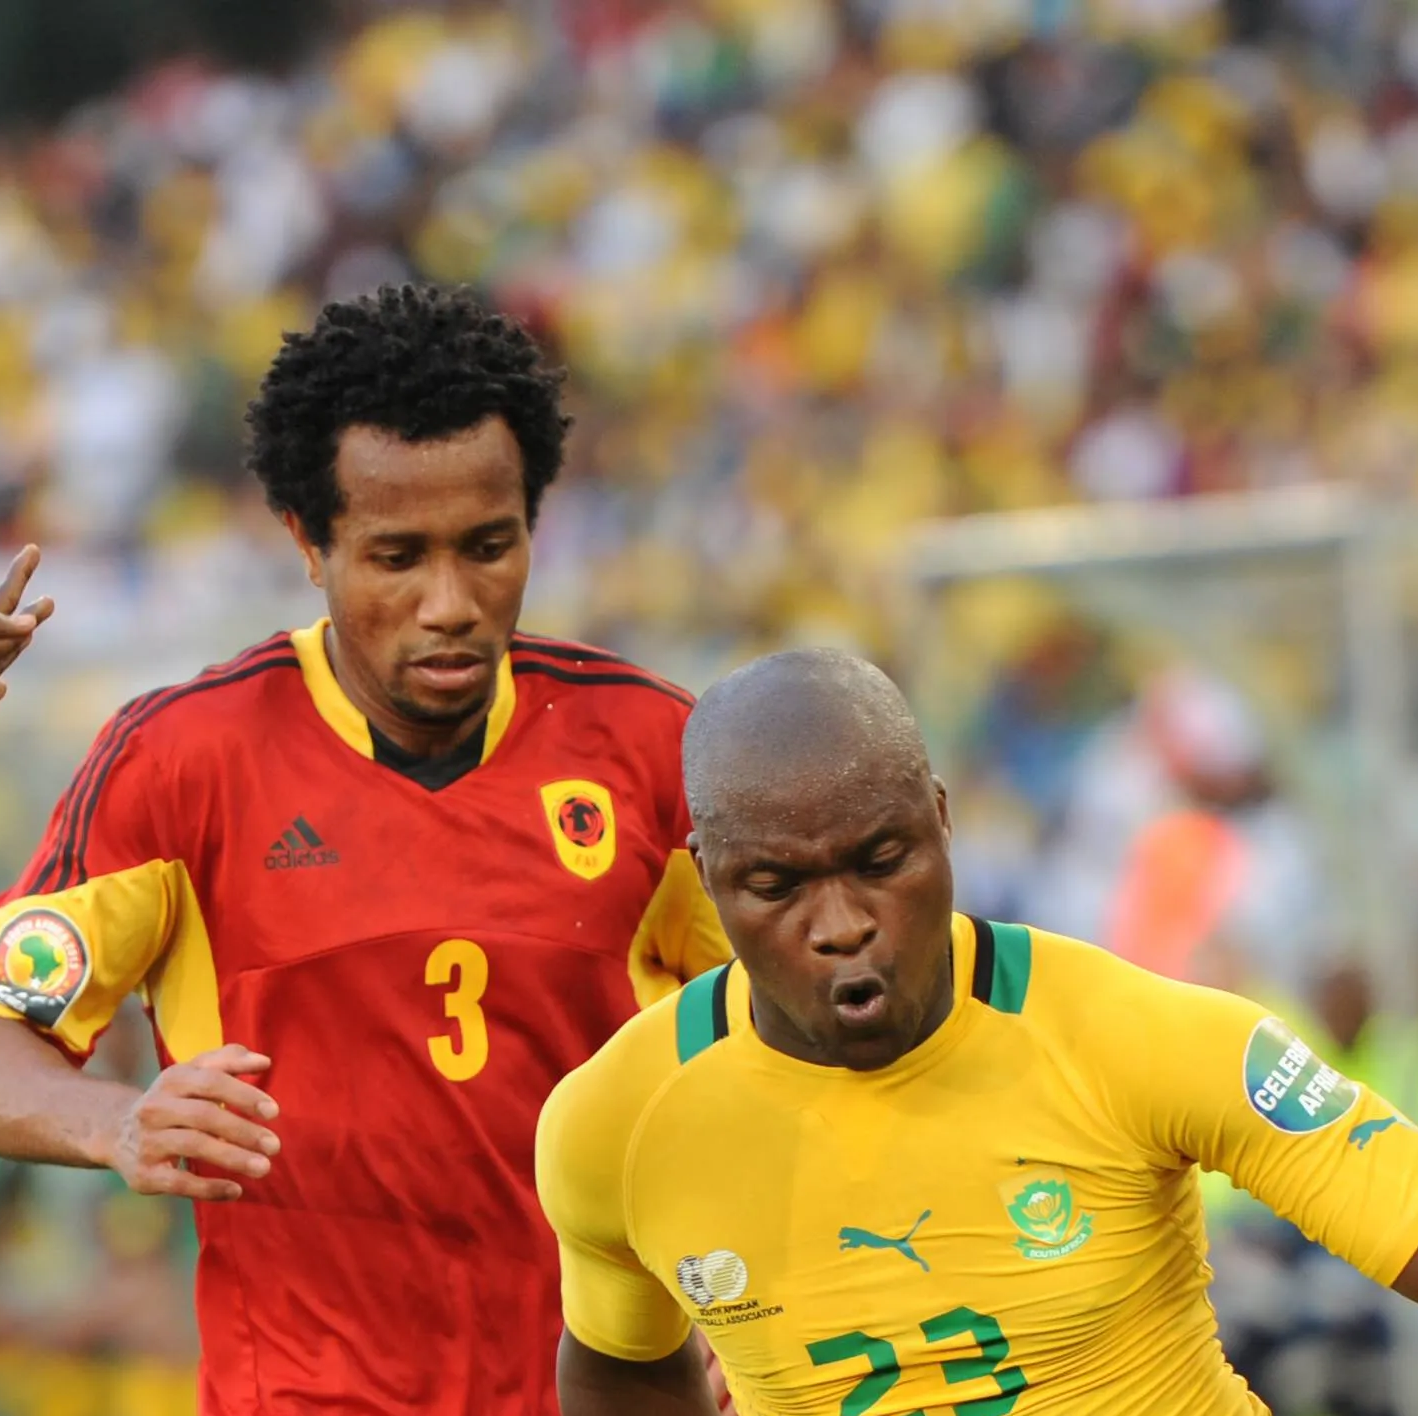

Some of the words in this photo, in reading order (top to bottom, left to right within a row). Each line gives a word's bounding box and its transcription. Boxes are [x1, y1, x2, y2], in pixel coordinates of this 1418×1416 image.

[264, 849, 340, 870] adidas
[424, 938, 488, 1082] 3
[1028, 1249, 1060, 1258] SOUTH
[1060, 1232, 1089, 1254] AFRICA
[726, 1305, 784, 1325] ASSOCIATION
